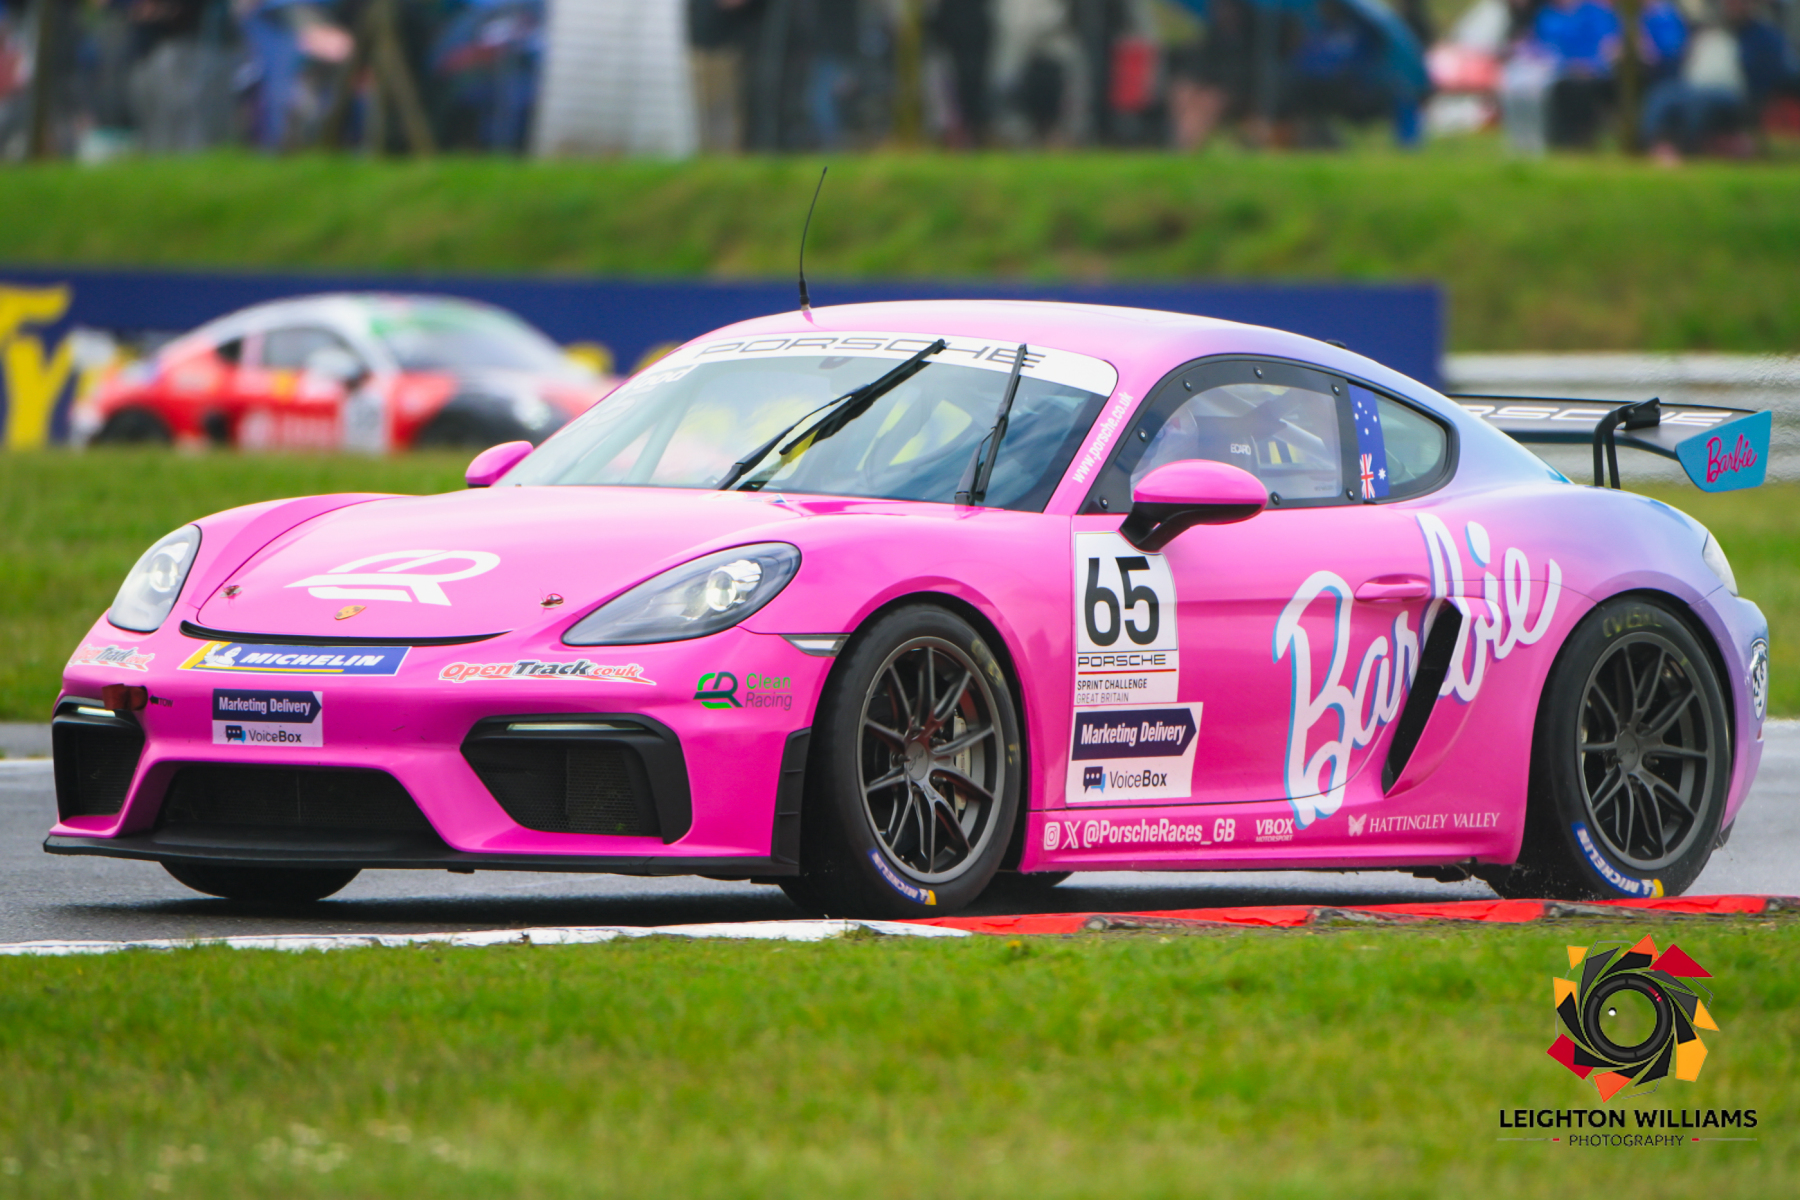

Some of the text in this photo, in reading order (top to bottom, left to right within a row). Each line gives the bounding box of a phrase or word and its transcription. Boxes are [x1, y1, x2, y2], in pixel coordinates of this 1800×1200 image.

[694, 338, 1047, 369] PORSCHE
[1458, 404, 1733, 427] RSCE
[1072, 391, 1134, 483] www.porsche.co.uk
[1706, 433, 1758, 483] Barbie
[1085, 556, 1160, 647] 65
[240, 652, 386, 666] MICHELIN
[1077, 654, 1167, 668] PORSCHE
[746, 673, 791, 689] Clean
[1273, 512, 1562, 830] Barbie
[1077, 678, 1147, 690] SPRINT CHALLENGE
[218, 697, 311, 716] Marketing Delivery
[745, 691, 792, 711] Racing
[1076, 692, 1129, 704] GREAT BRITAIN
[248, 729, 302, 743] VoiceBox
[1081, 721, 1187, 747] Marketing Delivery
[1109, 769, 1168, 789] VoiceBox
[1256, 818, 1294, 836] VBOX
[1369, 812, 1500, 833] HATTINGLEY VALLEY
[1083, 818, 1236, 848] @PorscheRaces_GB
[1577, 827, 1641, 893] MICHELIN
